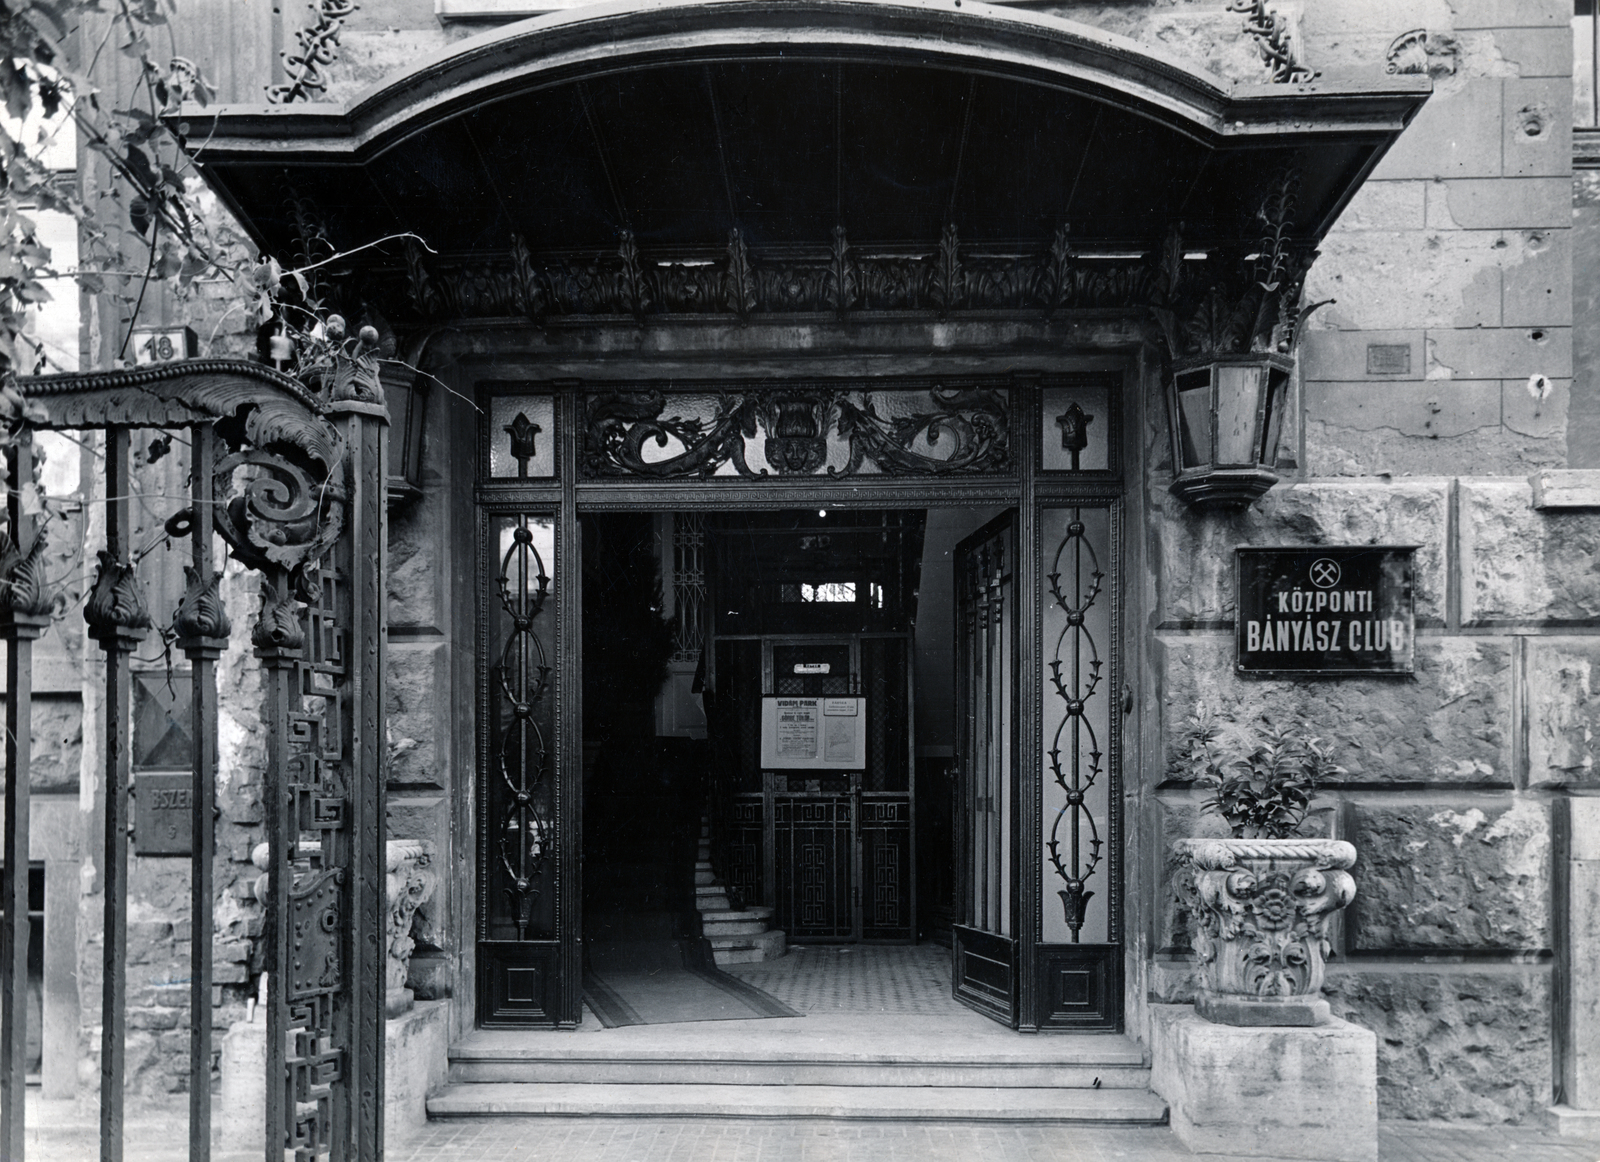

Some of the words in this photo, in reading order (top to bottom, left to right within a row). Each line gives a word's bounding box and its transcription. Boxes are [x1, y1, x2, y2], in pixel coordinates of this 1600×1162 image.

[140, 336, 174, 361] 18
[1278, 586, 1373, 613] KÖZPONTI
[1247, 614, 1342, 652] BÁNYÁSZ
[1349, 620, 1404, 652] CLUB
